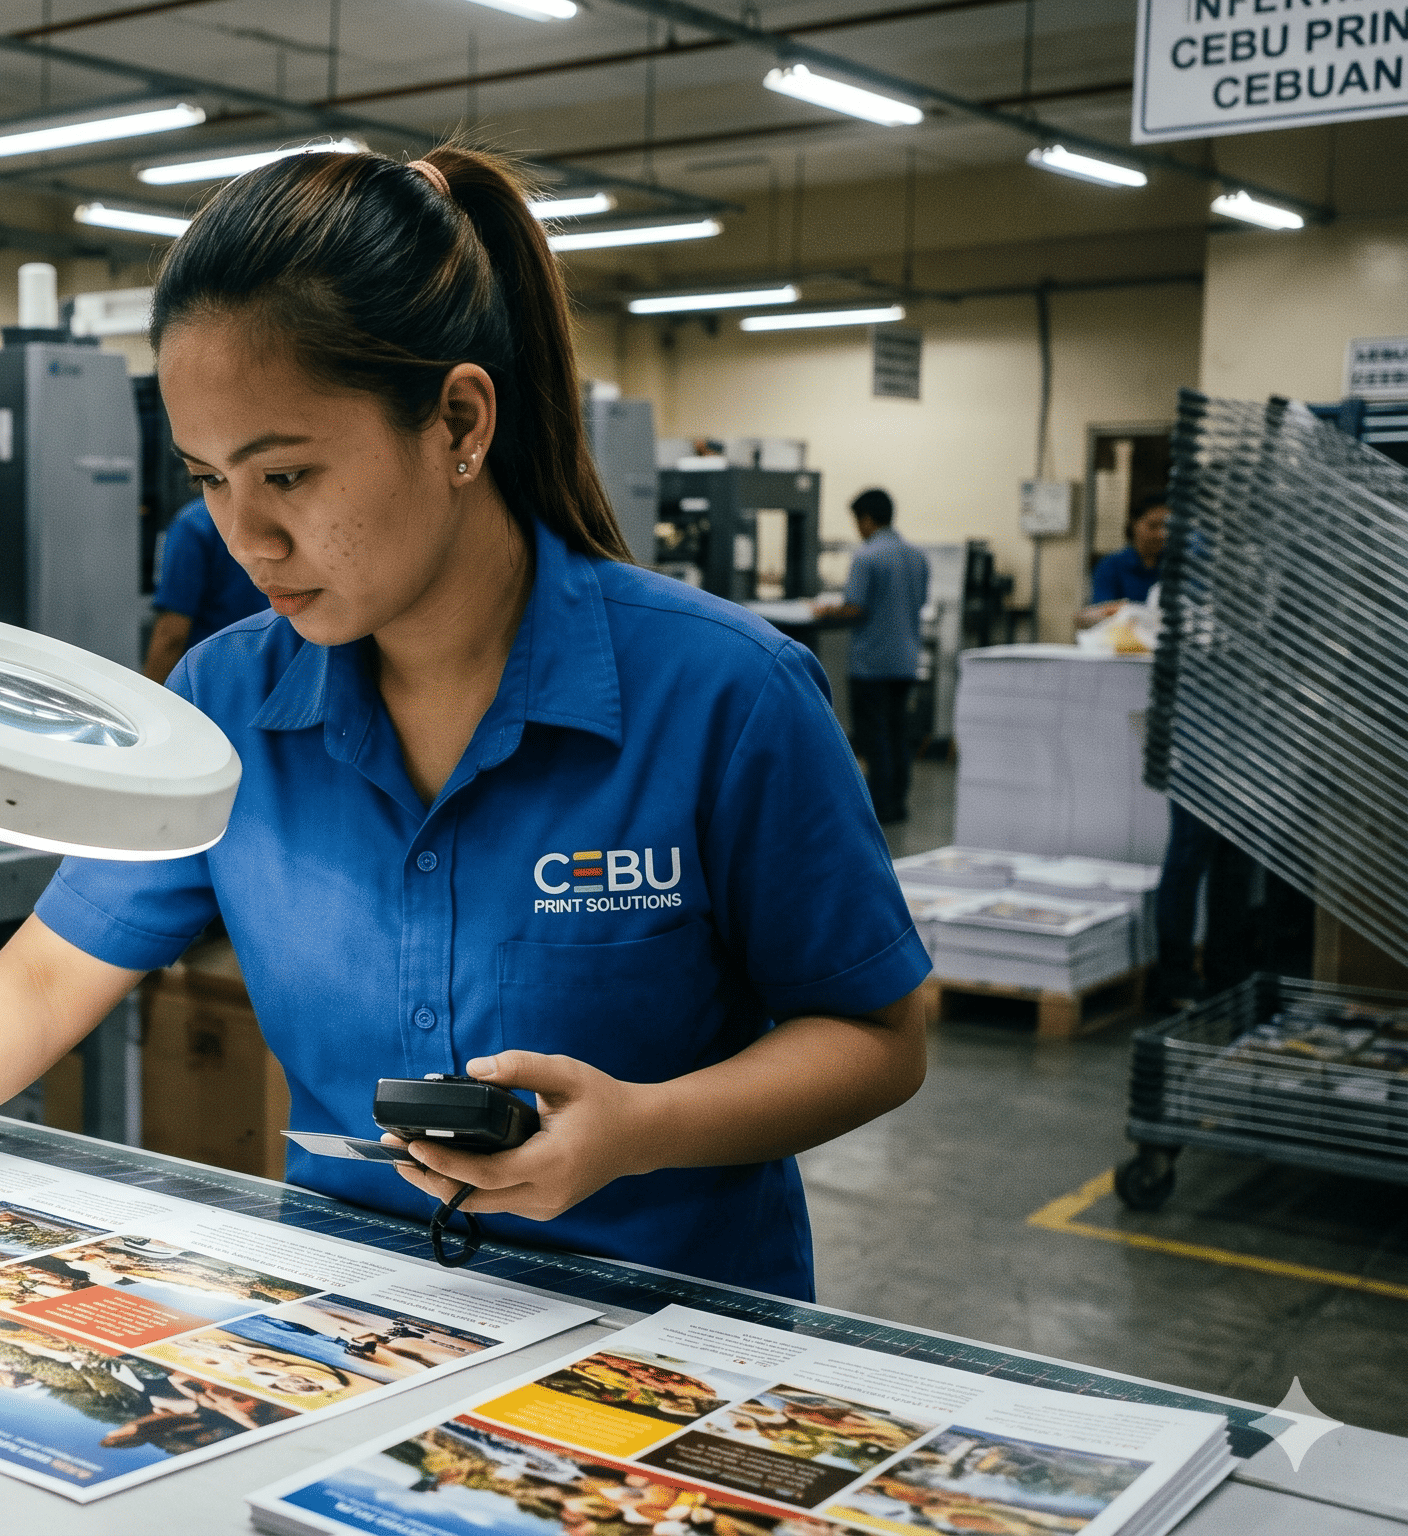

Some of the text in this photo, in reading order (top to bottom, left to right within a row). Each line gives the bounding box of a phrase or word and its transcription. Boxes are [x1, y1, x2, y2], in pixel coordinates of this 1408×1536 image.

[1171, 23, 1289, 69] CEBU
[1213, 56, 1403, 109] CEBUAN
[534, 847, 681, 894] CEBU
[534, 893, 682, 914] PRINT SOLUTIONS
